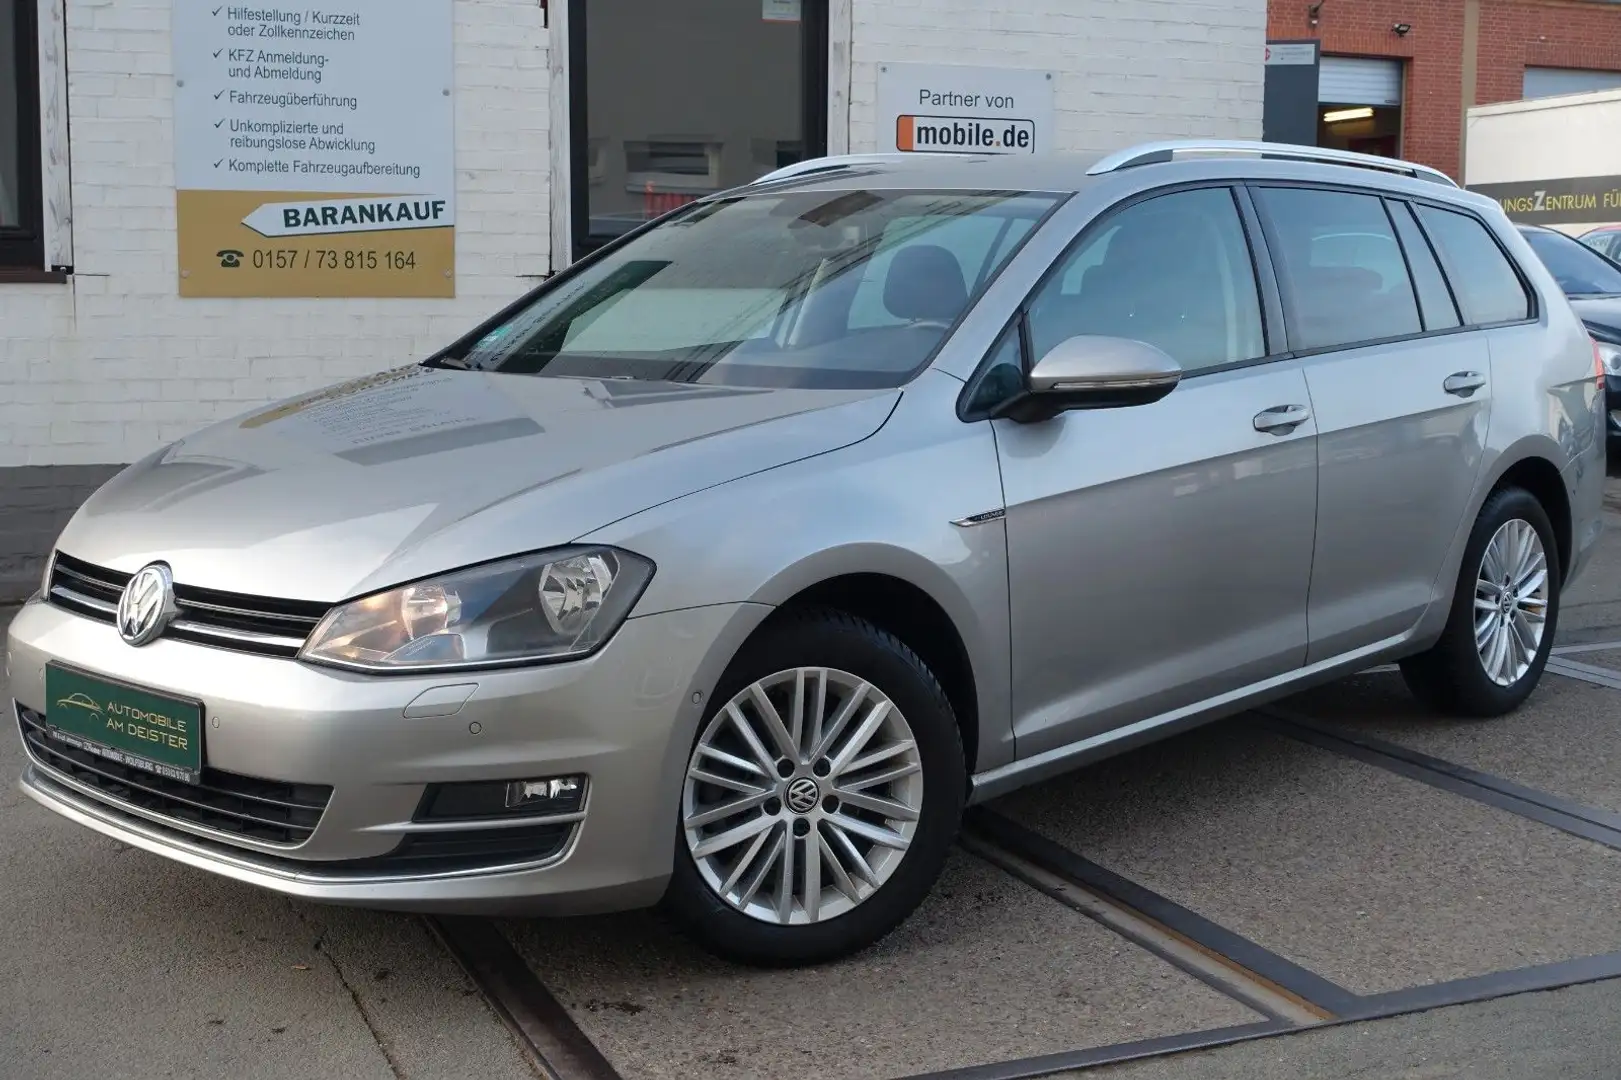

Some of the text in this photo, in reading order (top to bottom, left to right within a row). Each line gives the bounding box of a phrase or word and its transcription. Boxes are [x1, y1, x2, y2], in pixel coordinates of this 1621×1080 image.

[227, 6, 301, 26] Hilfestellung
[312, 11, 361, 26] Kurzzeit
[227, 25, 356, 41] oder Zollkennzeichen
[228, 49, 329, 68] KFZ Anmeldung-
[228, 66, 322, 84] und Abmeldung
[229, 90, 357, 110] Fahrzeugüberführung
[919, 89, 1015, 109] Partner von
[229, 119, 344, 137] Unkomplizierte und
[916, 122, 1030, 148] mobile.de
[229, 136, 376, 155] reibungslose Abwicklung
[228, 159, 421, 179] Komplette Fahrzeugaufbereitung
[282, 200, 446, 229] BARANKAUF
[252, 249, 416, 270] 0157 / 73 815 164
[107, 702, 187, 733] AUTOMOBILE
[106, 717, 125, 733] AM
[127, 722, 188, 751] DEISTER
